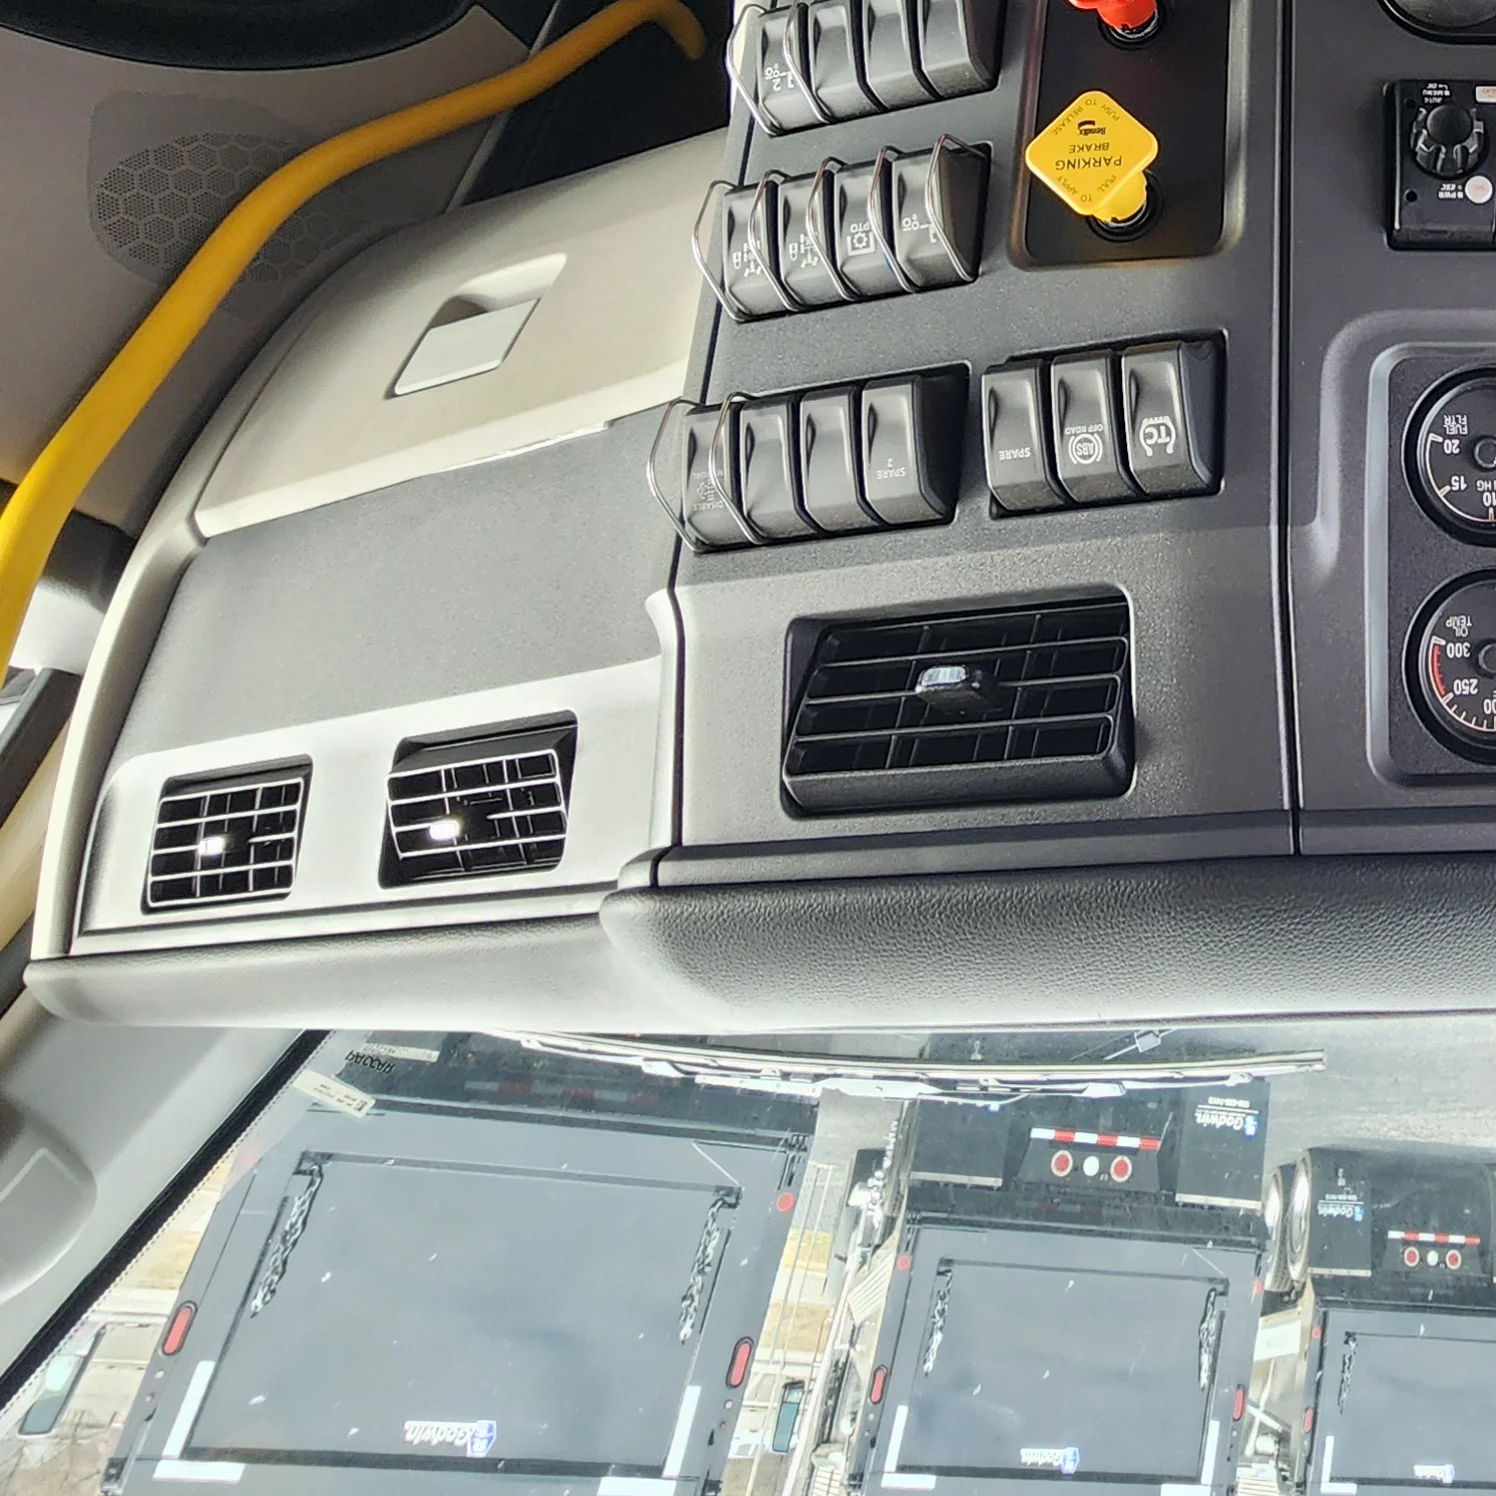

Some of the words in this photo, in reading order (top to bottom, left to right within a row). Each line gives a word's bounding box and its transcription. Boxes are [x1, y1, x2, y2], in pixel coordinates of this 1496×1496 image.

[772, 78, 781, 92] 2
[1085, 98, 1097, 106] TO
[1100, 104, 1120, 121] PUSH
[1050, 105, 1083, 135] RELEASE
[1079, 127, 1106, 136] Bendix
[1068, 142, 1110, 154] BRAKE
[1055, 155, 1122, 171] PARKING
[1055, 176, 1078, 195] APPLY
[1097, 174, 1117, 192] PULL
[1080, 194, 1092, 202] TO
[850, 222, 870, 233] PTO
[1443, 414, 1468, 425] FLTR
[1064, 425, 1087, 434] ROAD
[1087, 423, 1103, 433] OFF
[1443, 424, 1468, 435] FUEL
[1144, 425, 1170, 445] TC
[1076, 442, 1094, 456] ABS
[1443, 439, 1460, 454] 20
[998, 446, 1031, 461] SPARE
[887, 458, 894, 468] 2
[876, 467, 906, 479] SPARE
[1451, 475, 1468, 490] 15
[1476, 479, 1493, 490] HG
[1445, 615, 1472, 627] TEMP
[1452, 626, 1469, 637] OIL
[1446, 642, 1471, 658] 300
[1453, 679, 1478, 695] 250
